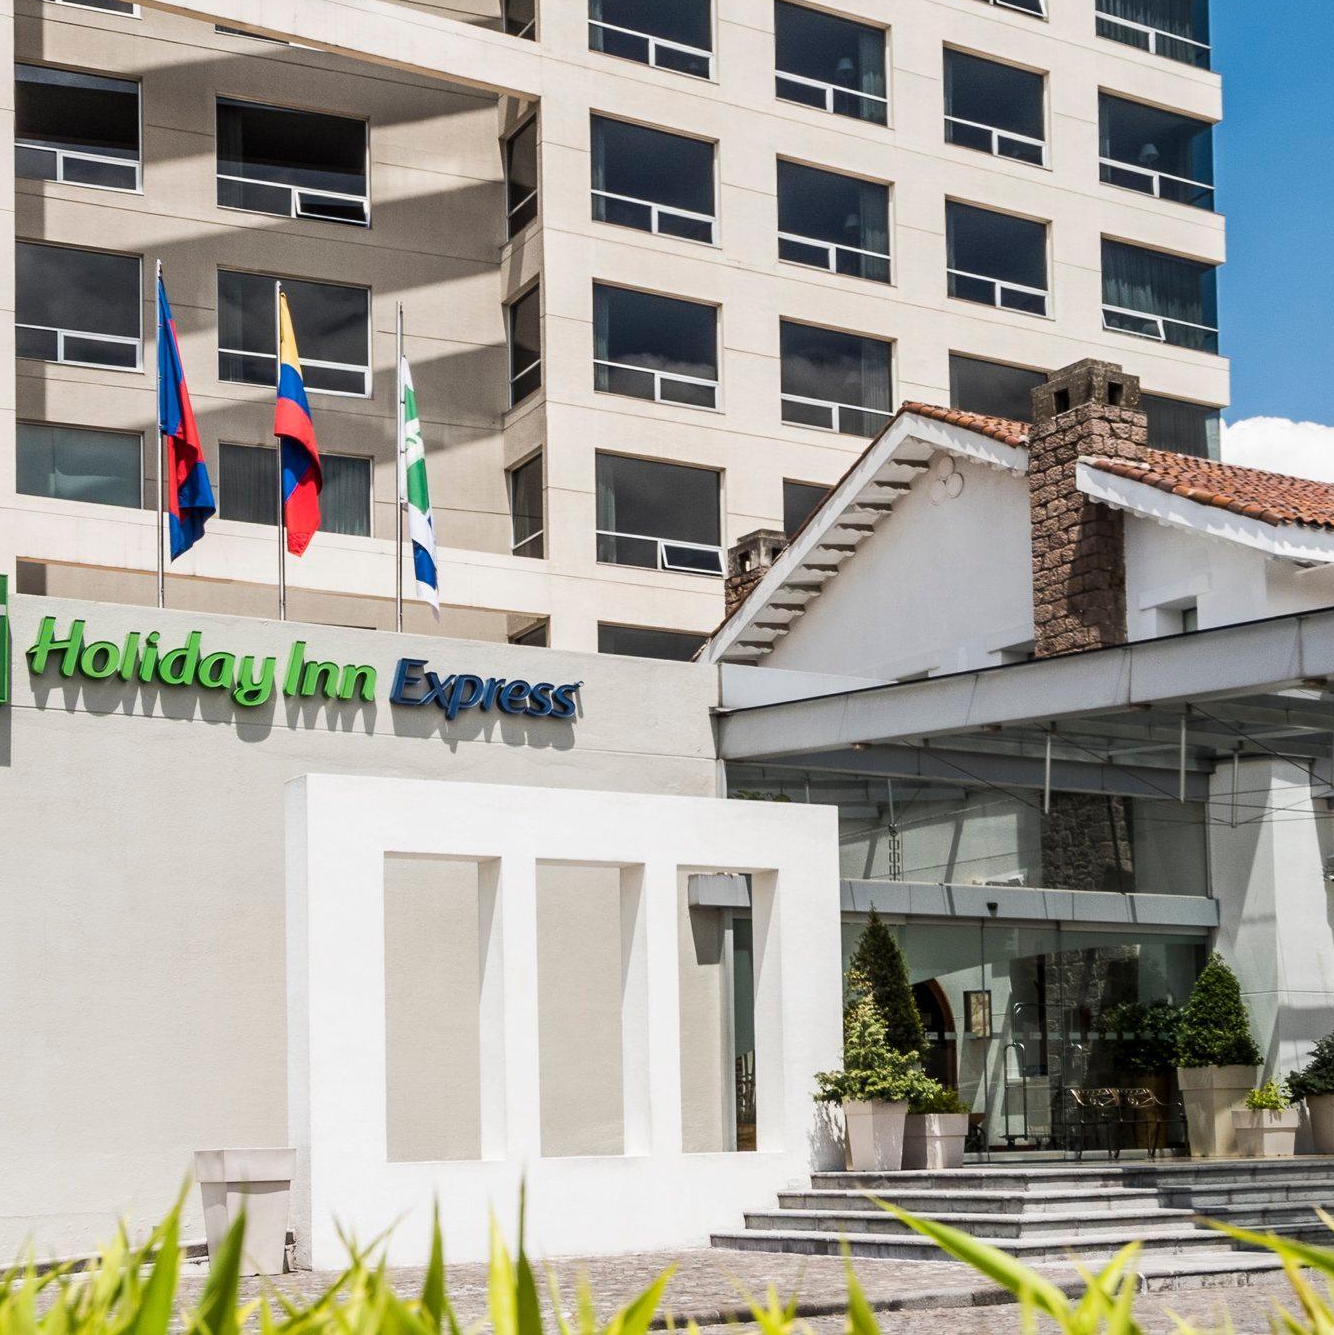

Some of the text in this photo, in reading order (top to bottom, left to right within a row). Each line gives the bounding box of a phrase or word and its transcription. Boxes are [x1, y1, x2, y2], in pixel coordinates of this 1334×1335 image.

[26, 616, 576, 720] Holiday Inn Express
